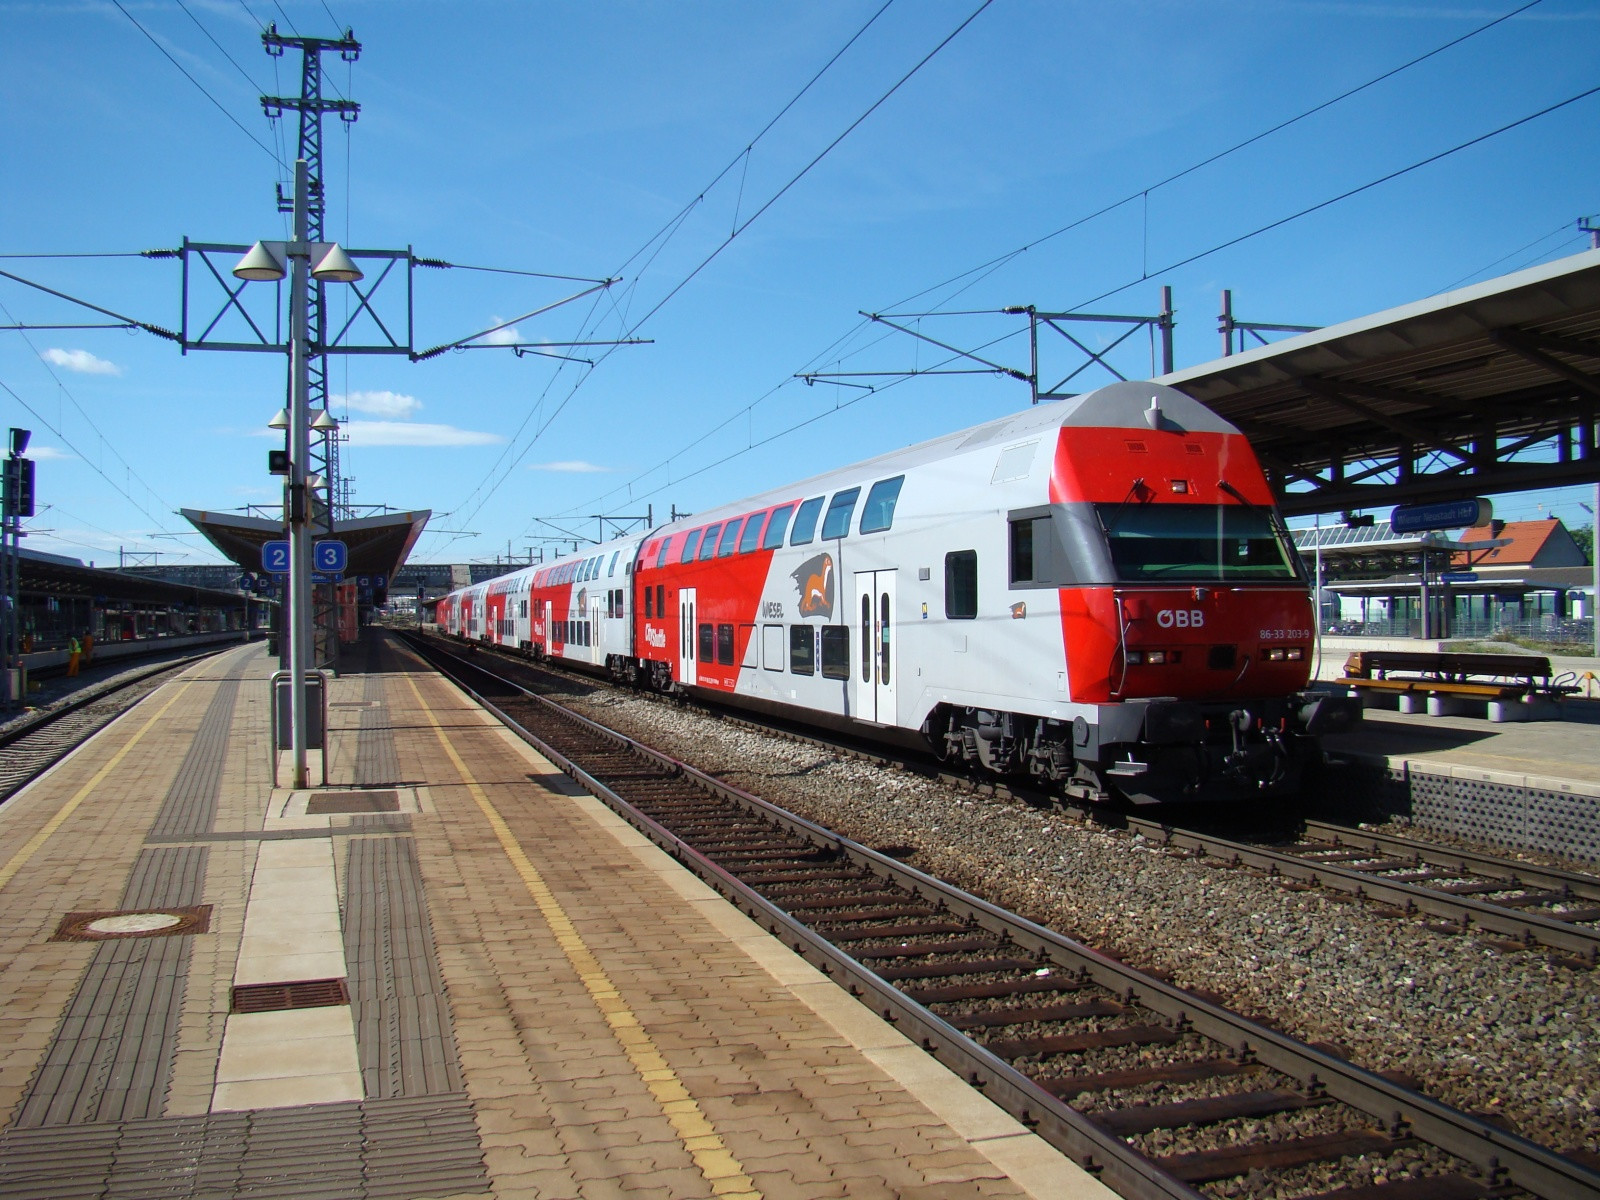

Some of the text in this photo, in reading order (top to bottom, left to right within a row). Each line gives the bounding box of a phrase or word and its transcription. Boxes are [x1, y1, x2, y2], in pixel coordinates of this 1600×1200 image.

[273, 549, 286, 566] 2
[324, 548, 338, 566] 3
[243, 578, 251, 588] 2
[1156, 609, 1204, 628] ÖBB
[1259, 629, 1310, 640] 86-33 203-9
